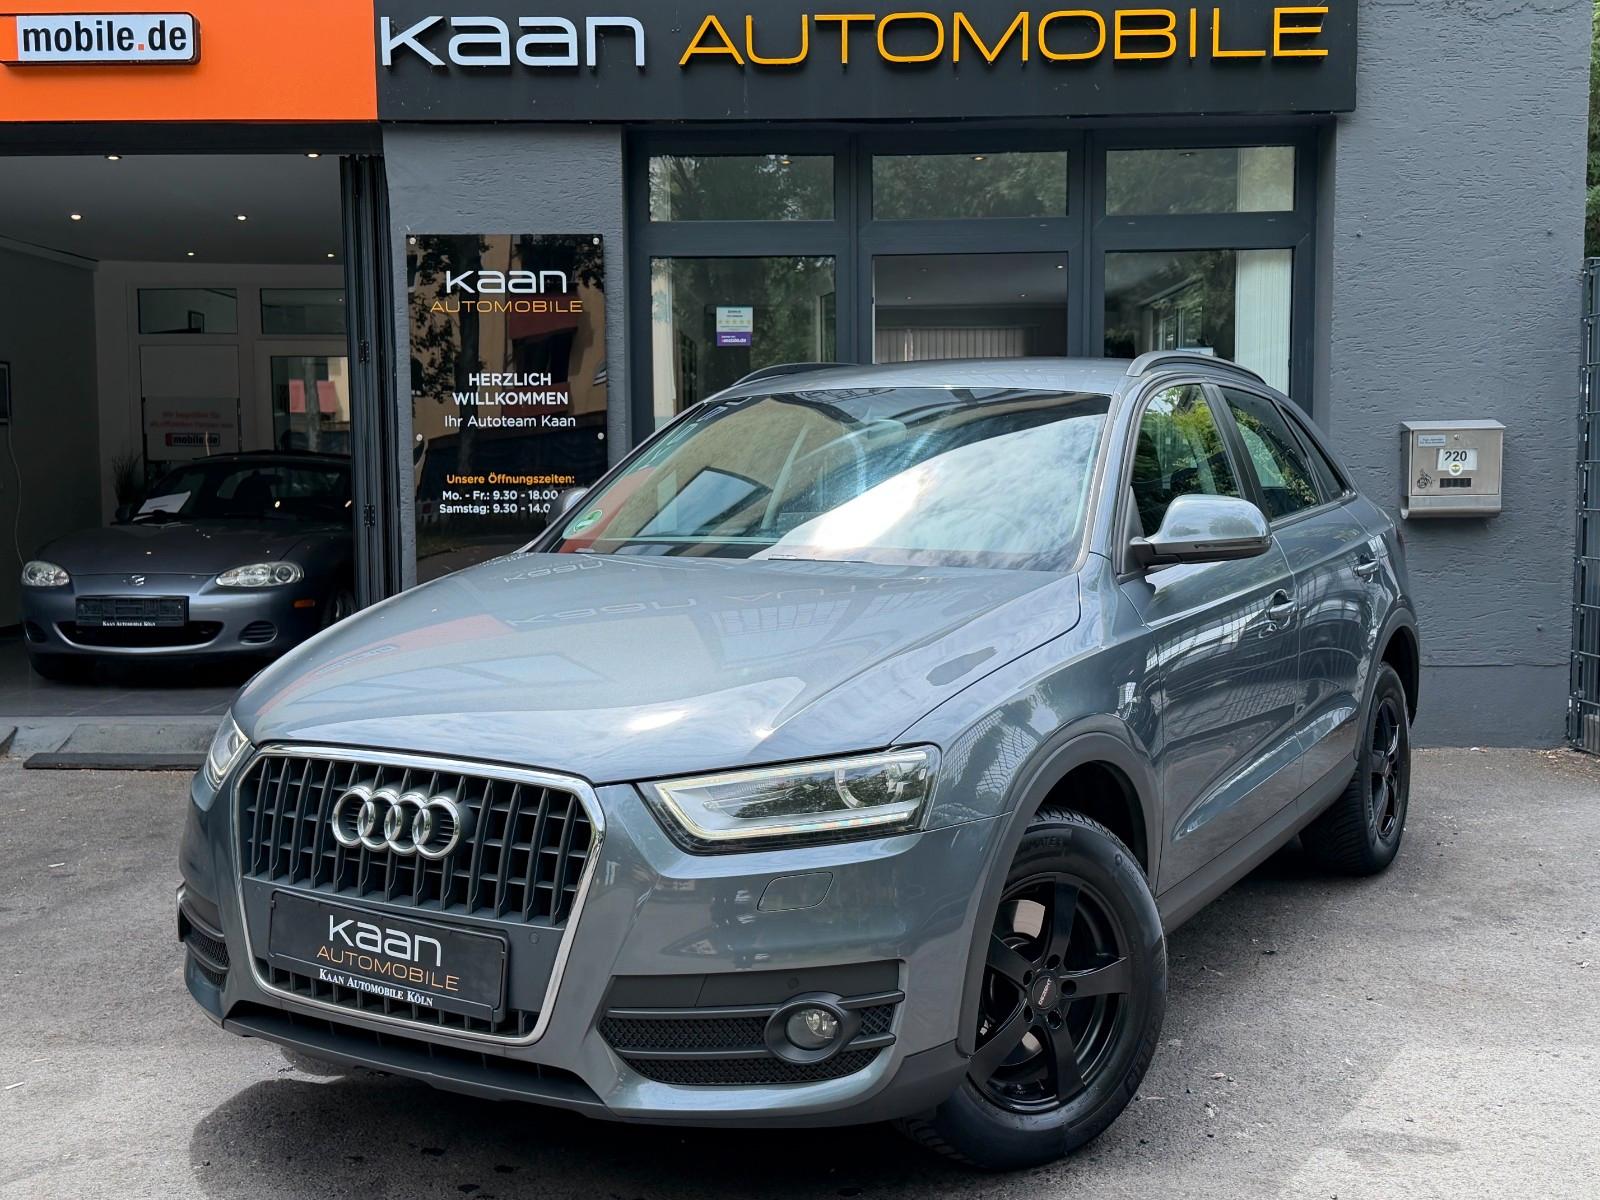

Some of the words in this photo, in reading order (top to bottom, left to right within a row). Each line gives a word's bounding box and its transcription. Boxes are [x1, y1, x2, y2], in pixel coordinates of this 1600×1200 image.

[22, 19, 188, 53] mobile.de
[380, 15, 645, 67] kaan
[679, 7, 1329, 66] AUTOMOBILE
[445, 270, 567, 294] kaan
[430, 300, 584, 313] AUTOMOBILE
[468, 372, 552, 387] HERZLICH
[452, 391, 569, 406] WILLKOMMEN
[444, 415, 463, 428] Ihr
[467, 415, 537, 428] Autoteam
[541, 415, 576, 428] Kaan
[1444, 450, 1468, 462] 220
[446, 474, 485, 485] Unsere
[488, 471, 575, 486] Öffnungszeiten:
[442, 490, 463, 501] Mo.
[472, 490, 490, 501] Fr.:
[492, 490, 518, 501] 9.30
[528, 490, 559, 501] 18.00
[439, 503, 490, 515] Samstag:
[492, 503, 518, 514] 9.30
[528, 503, 551, 514] 14.0
[329, 914, 442, 967] kaan
[316, 945, 460, 992] AUTOMOBILE
